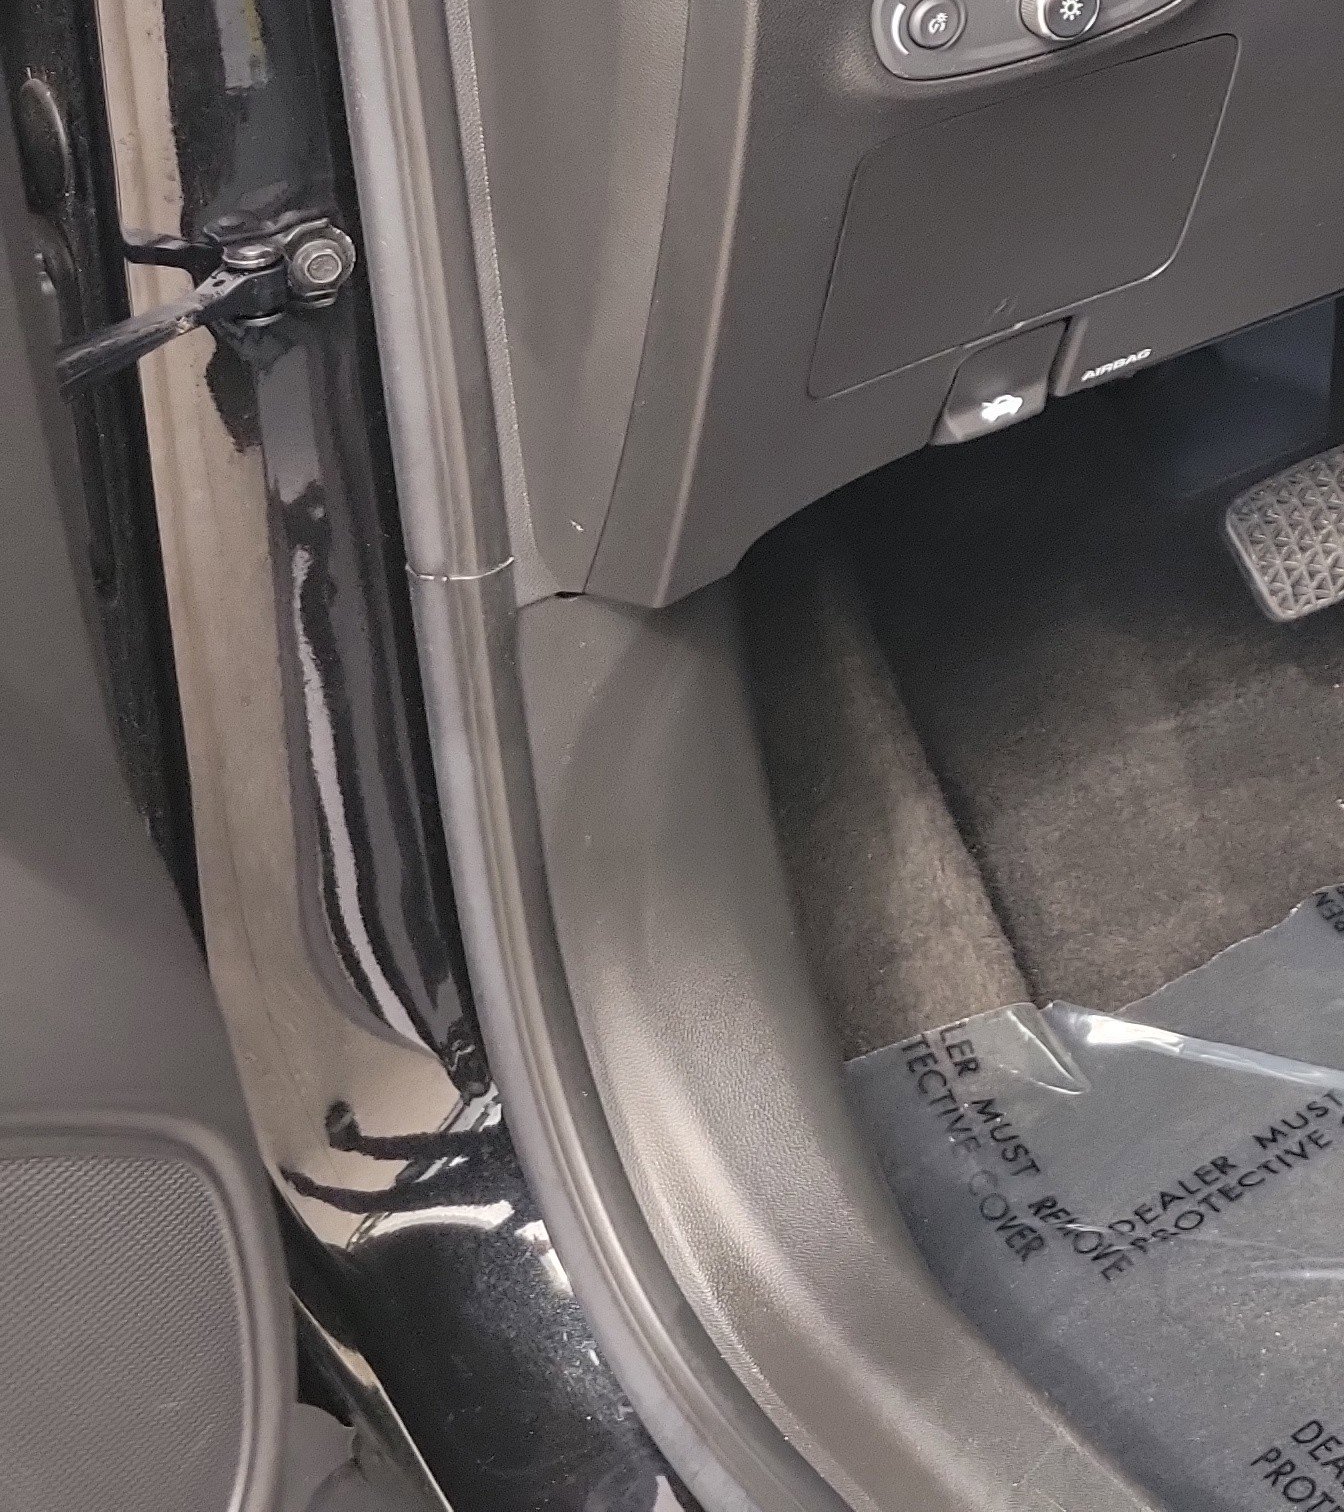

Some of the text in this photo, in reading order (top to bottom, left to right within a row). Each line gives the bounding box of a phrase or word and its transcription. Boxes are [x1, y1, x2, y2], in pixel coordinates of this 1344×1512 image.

[1081, 348, 1152, 381] AIRBAG
[971, 1098, 1041, 1176] MUST
[1109, 1155, 1237, 1236] DEALER
[1253, 1089, 1344, 1150] MUST
[968, 1169, 1044, 1262] COVER
